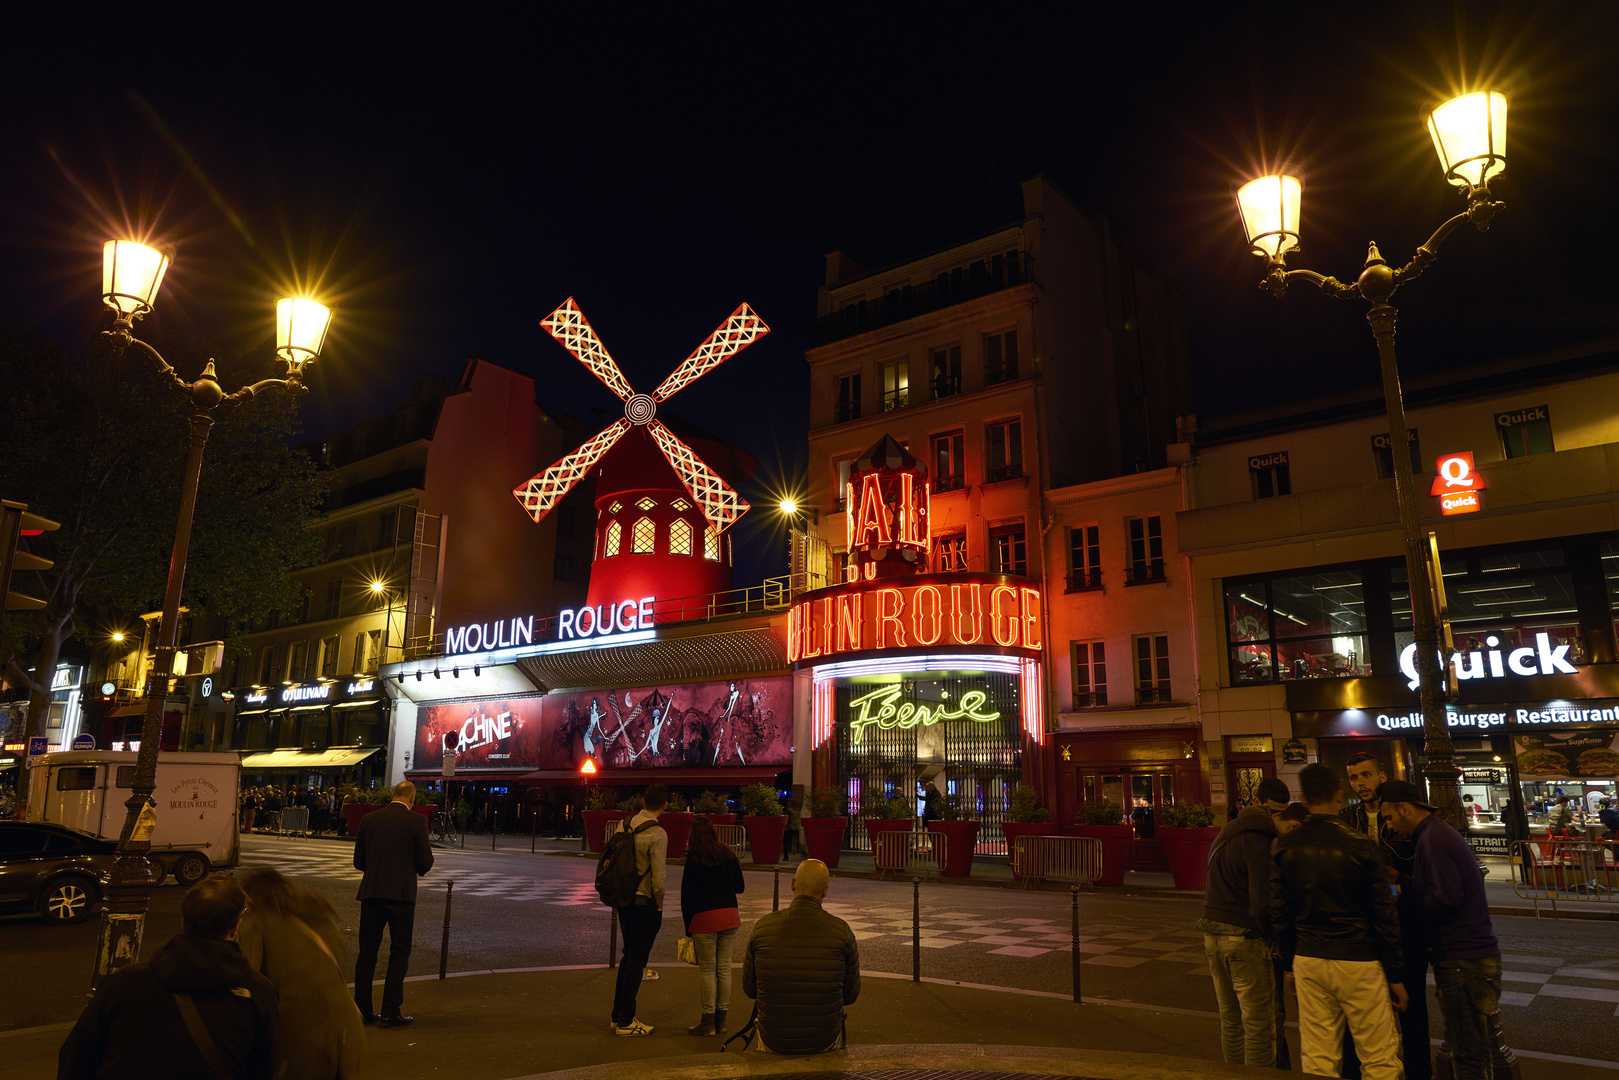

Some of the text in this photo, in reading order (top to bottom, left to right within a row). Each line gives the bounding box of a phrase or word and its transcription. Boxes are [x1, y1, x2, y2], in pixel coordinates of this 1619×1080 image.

[1497, 407, 1546, 428] Quick
[1249, 452, 1288, 469] Quick
[1440, 457, 1474, 488] Q
[846, 473, 928, 554] AL
[1442, 496, 1477, 510] Quick
[847, 562, 877, 583] DU
[445, 596, 656, 654] MOULIN ROUGE
[875, 583, 1042, 651] ROUGE
[849, 683, 1001, 745] Féerie
[1376, 705, 1619, 731] Qualit Burger Restaurant
[171, 777, 219, 794] Les Petits Chevaux
[169, 800, 218, 809] MOULIN ROUGE
